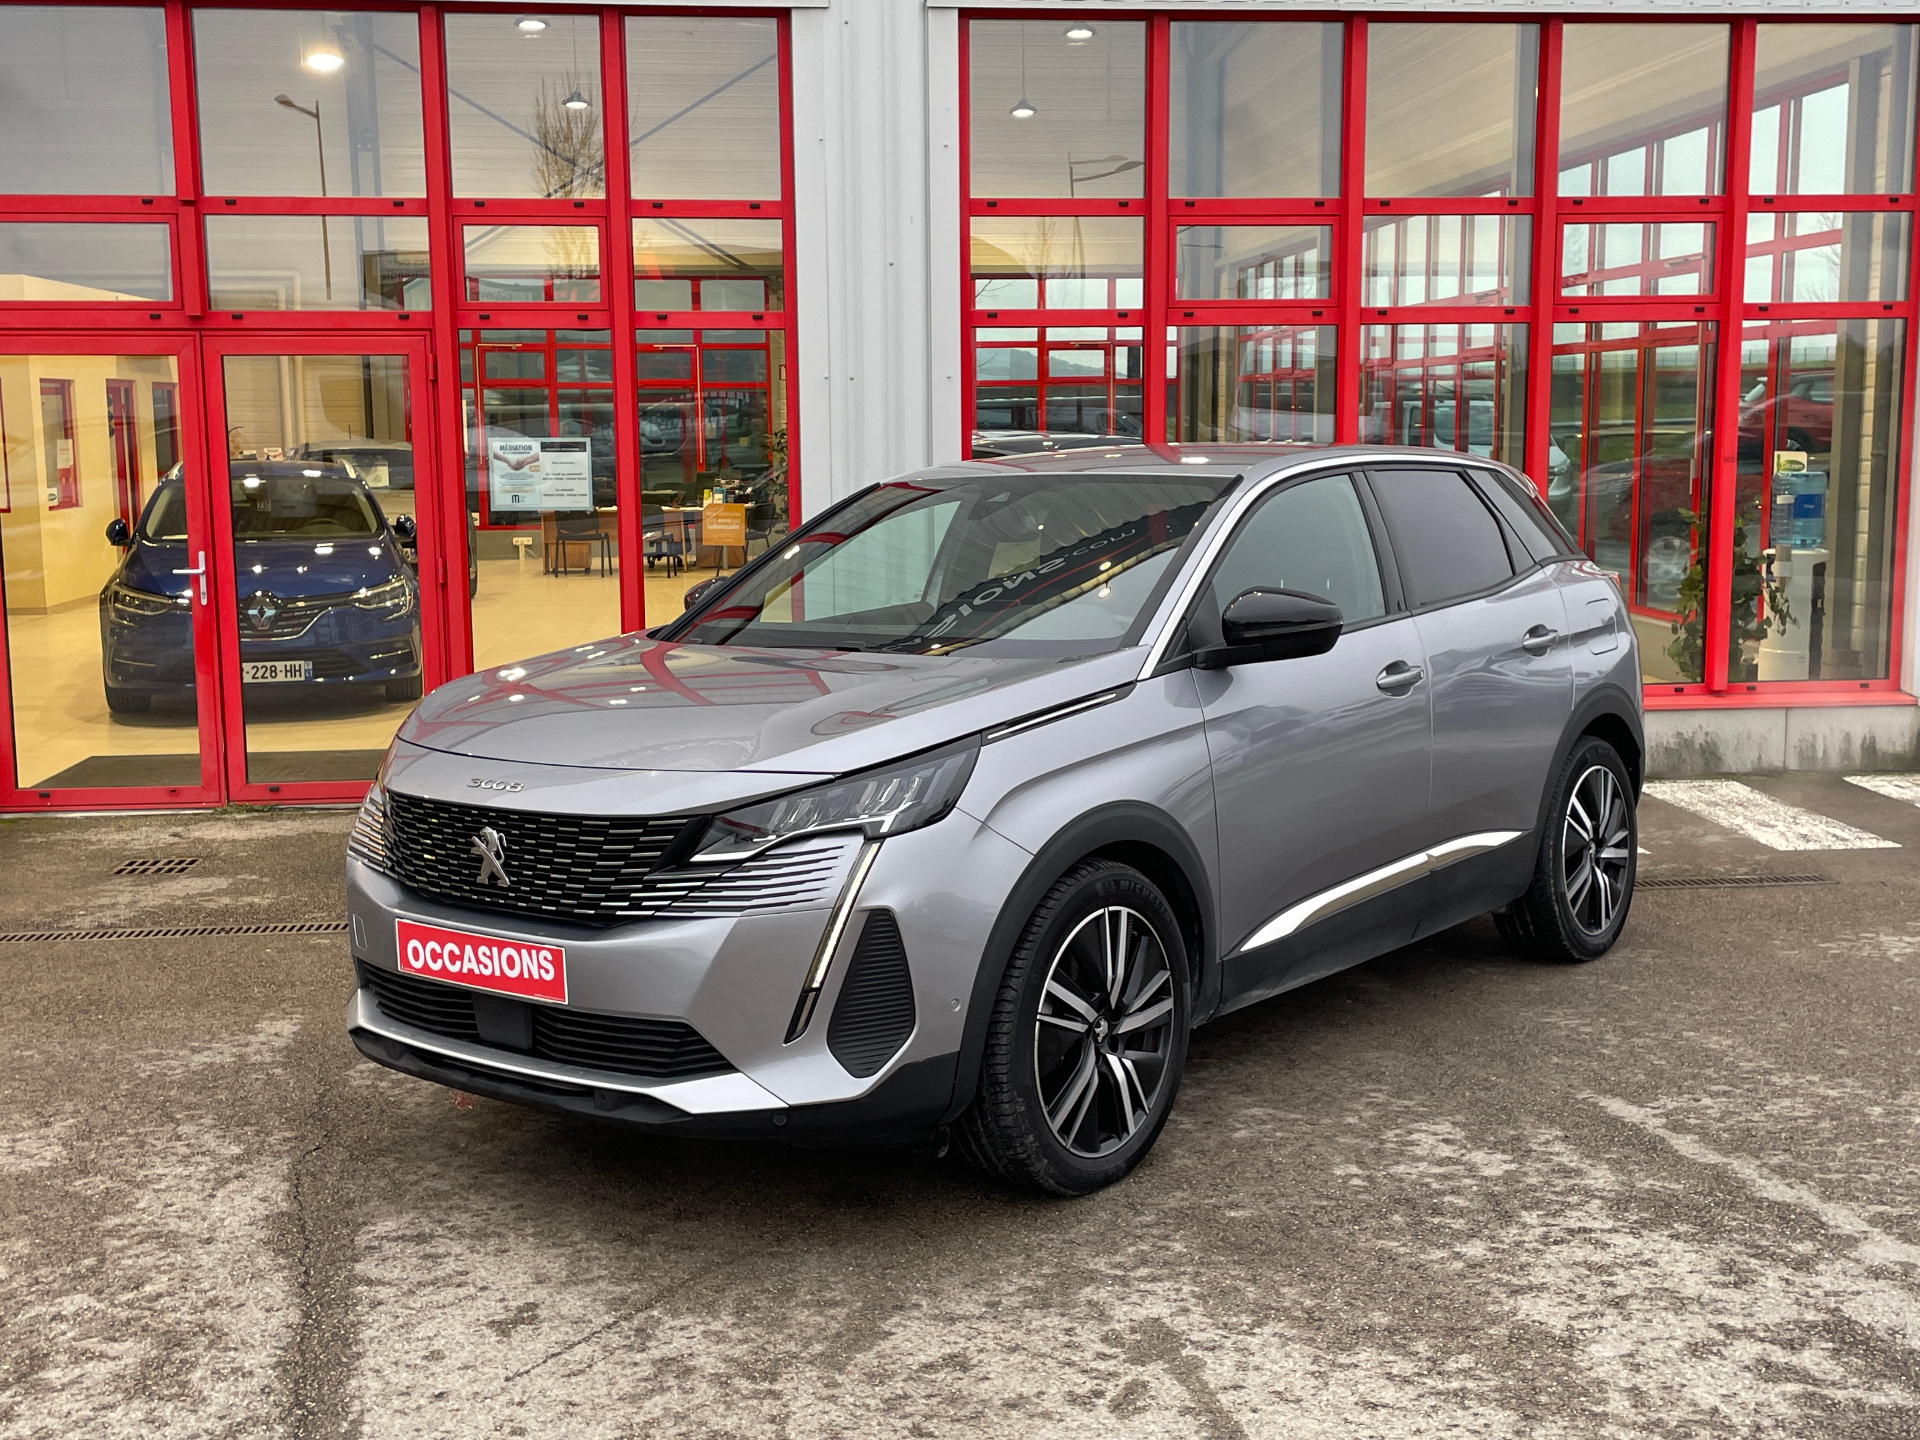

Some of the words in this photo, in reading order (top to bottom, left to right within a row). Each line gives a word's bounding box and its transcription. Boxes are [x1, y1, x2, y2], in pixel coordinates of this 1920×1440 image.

[499, 443, 533, 451] MÉDIATION
[466, 778, 525, 792] 3008
[406, 938, 556, 981] OCCASIONS
